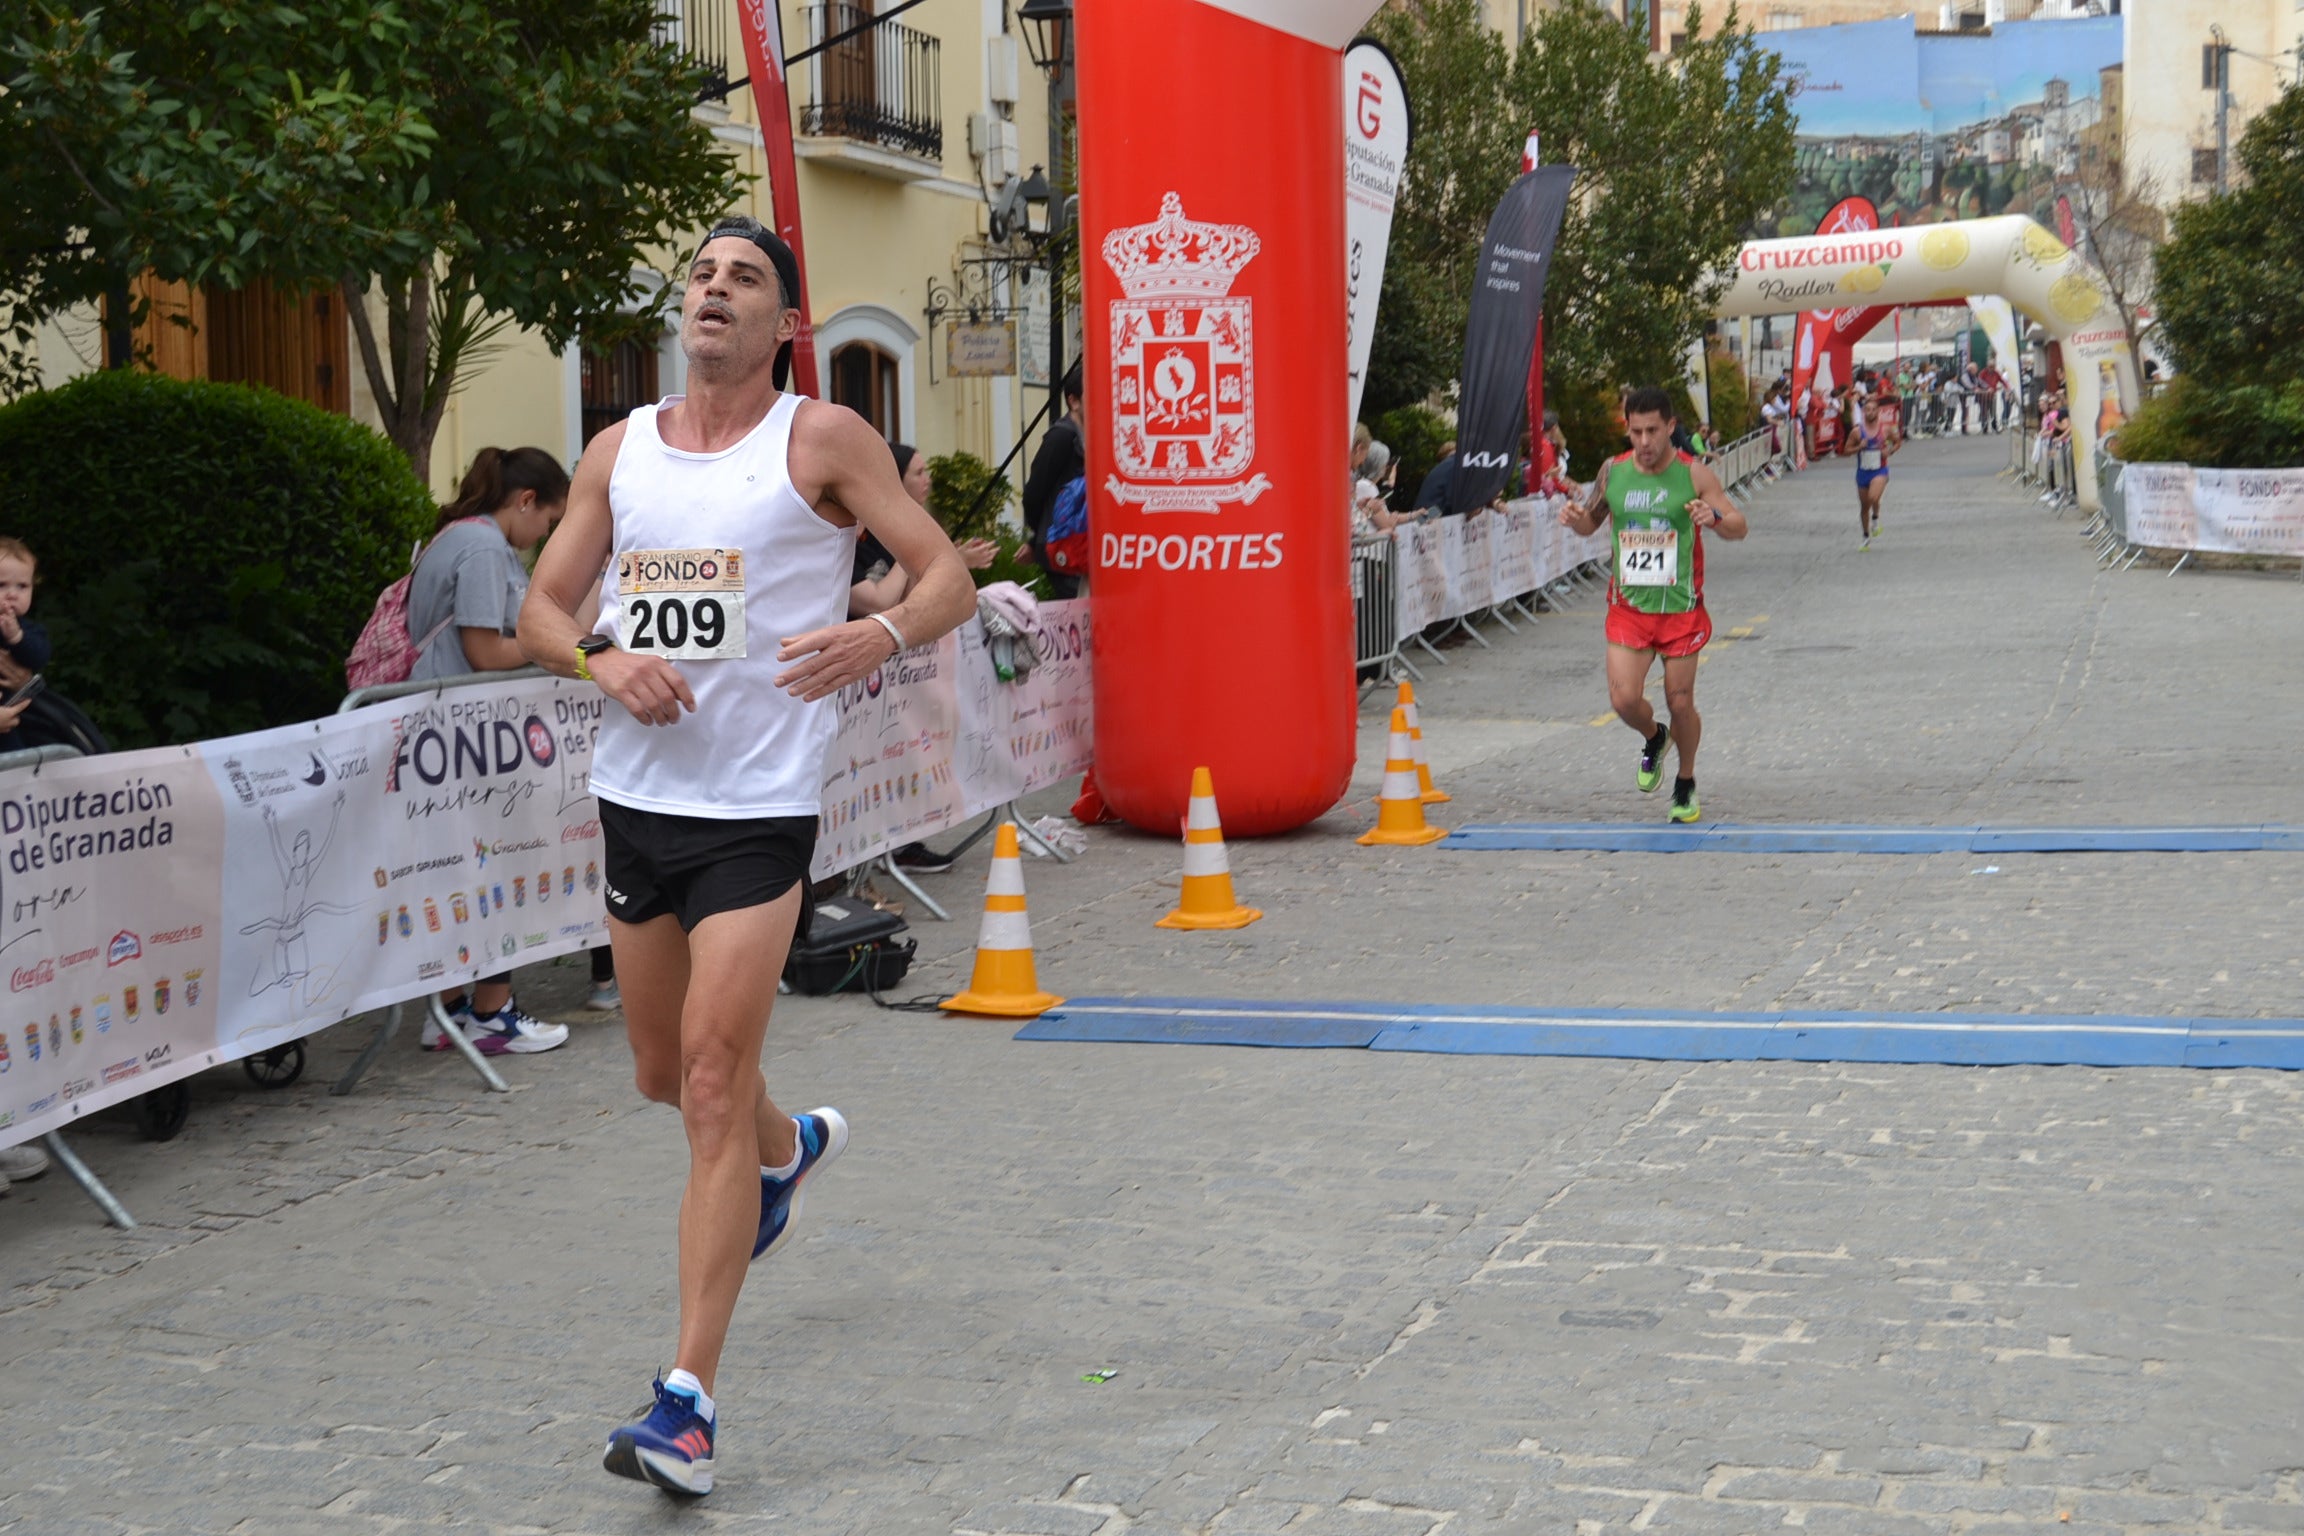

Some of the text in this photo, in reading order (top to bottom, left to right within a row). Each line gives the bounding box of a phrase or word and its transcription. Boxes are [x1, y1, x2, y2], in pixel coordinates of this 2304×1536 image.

[1346, 137, 1396, 173] iputación
[1493, 243, 1541, 263] Movement
[1741, 240, 1903, 272] Cruzcampo
[1490, 260, 1509, 274] that
[1487, 275, 1520, 293] inspires
[1758, 279, 1837, 303] Radler
[1462, 451, 1509, 469] KIA
[1100, 532, 1284, 571] DEPORTES
[1626, 551, 1665, 571] 421
[638, 559, 718, 581] FONDO
[630, 598, 726, 649] 209
[451, 696, 522, 727] PREMIO
[395, 715, 556, 793] FONDO
[529, 731, 550, 752] 24
[2, 777, 173, 839] Diputación
[10, 816, 174, 875] de Granada
